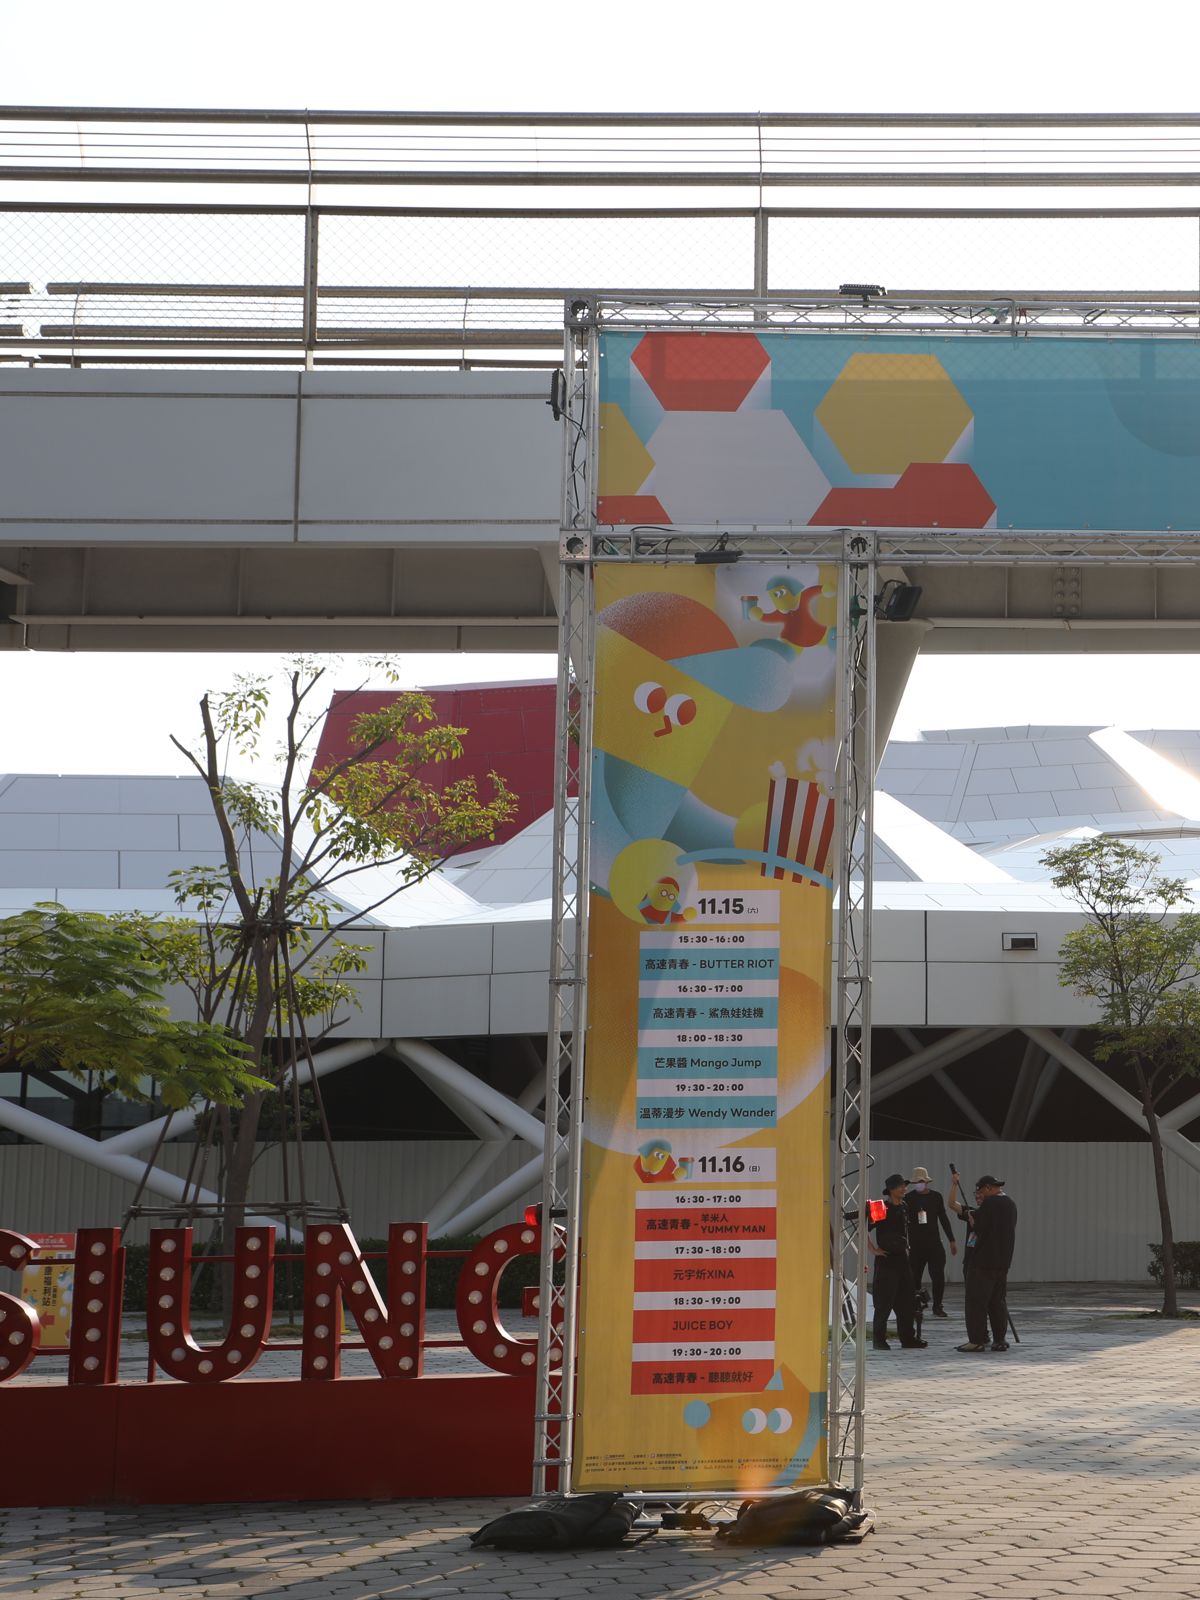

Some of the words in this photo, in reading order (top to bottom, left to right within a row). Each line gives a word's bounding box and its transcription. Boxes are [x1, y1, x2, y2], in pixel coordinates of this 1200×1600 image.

[697, 898, 745, 915] 11.15
[700, 959, 744, 969] BUTTER
[747, 959, 775, 969] RIOT
[690, 1058, 729, 1070] Mango
[731, 1058, 762, 1069] Jump
[688, 1108, 728, 1120] Wendy
[730, 1107, 775, 1118] Wander
[698, 1156, 745, 1173] 11.16
[701, 1225, 739, 1234] YUMMY
[742, 1224, 766, 1233] MAN
[672, 1320, 706, 1331] JUICE
[709, 1320, 733, 1330] BOY
